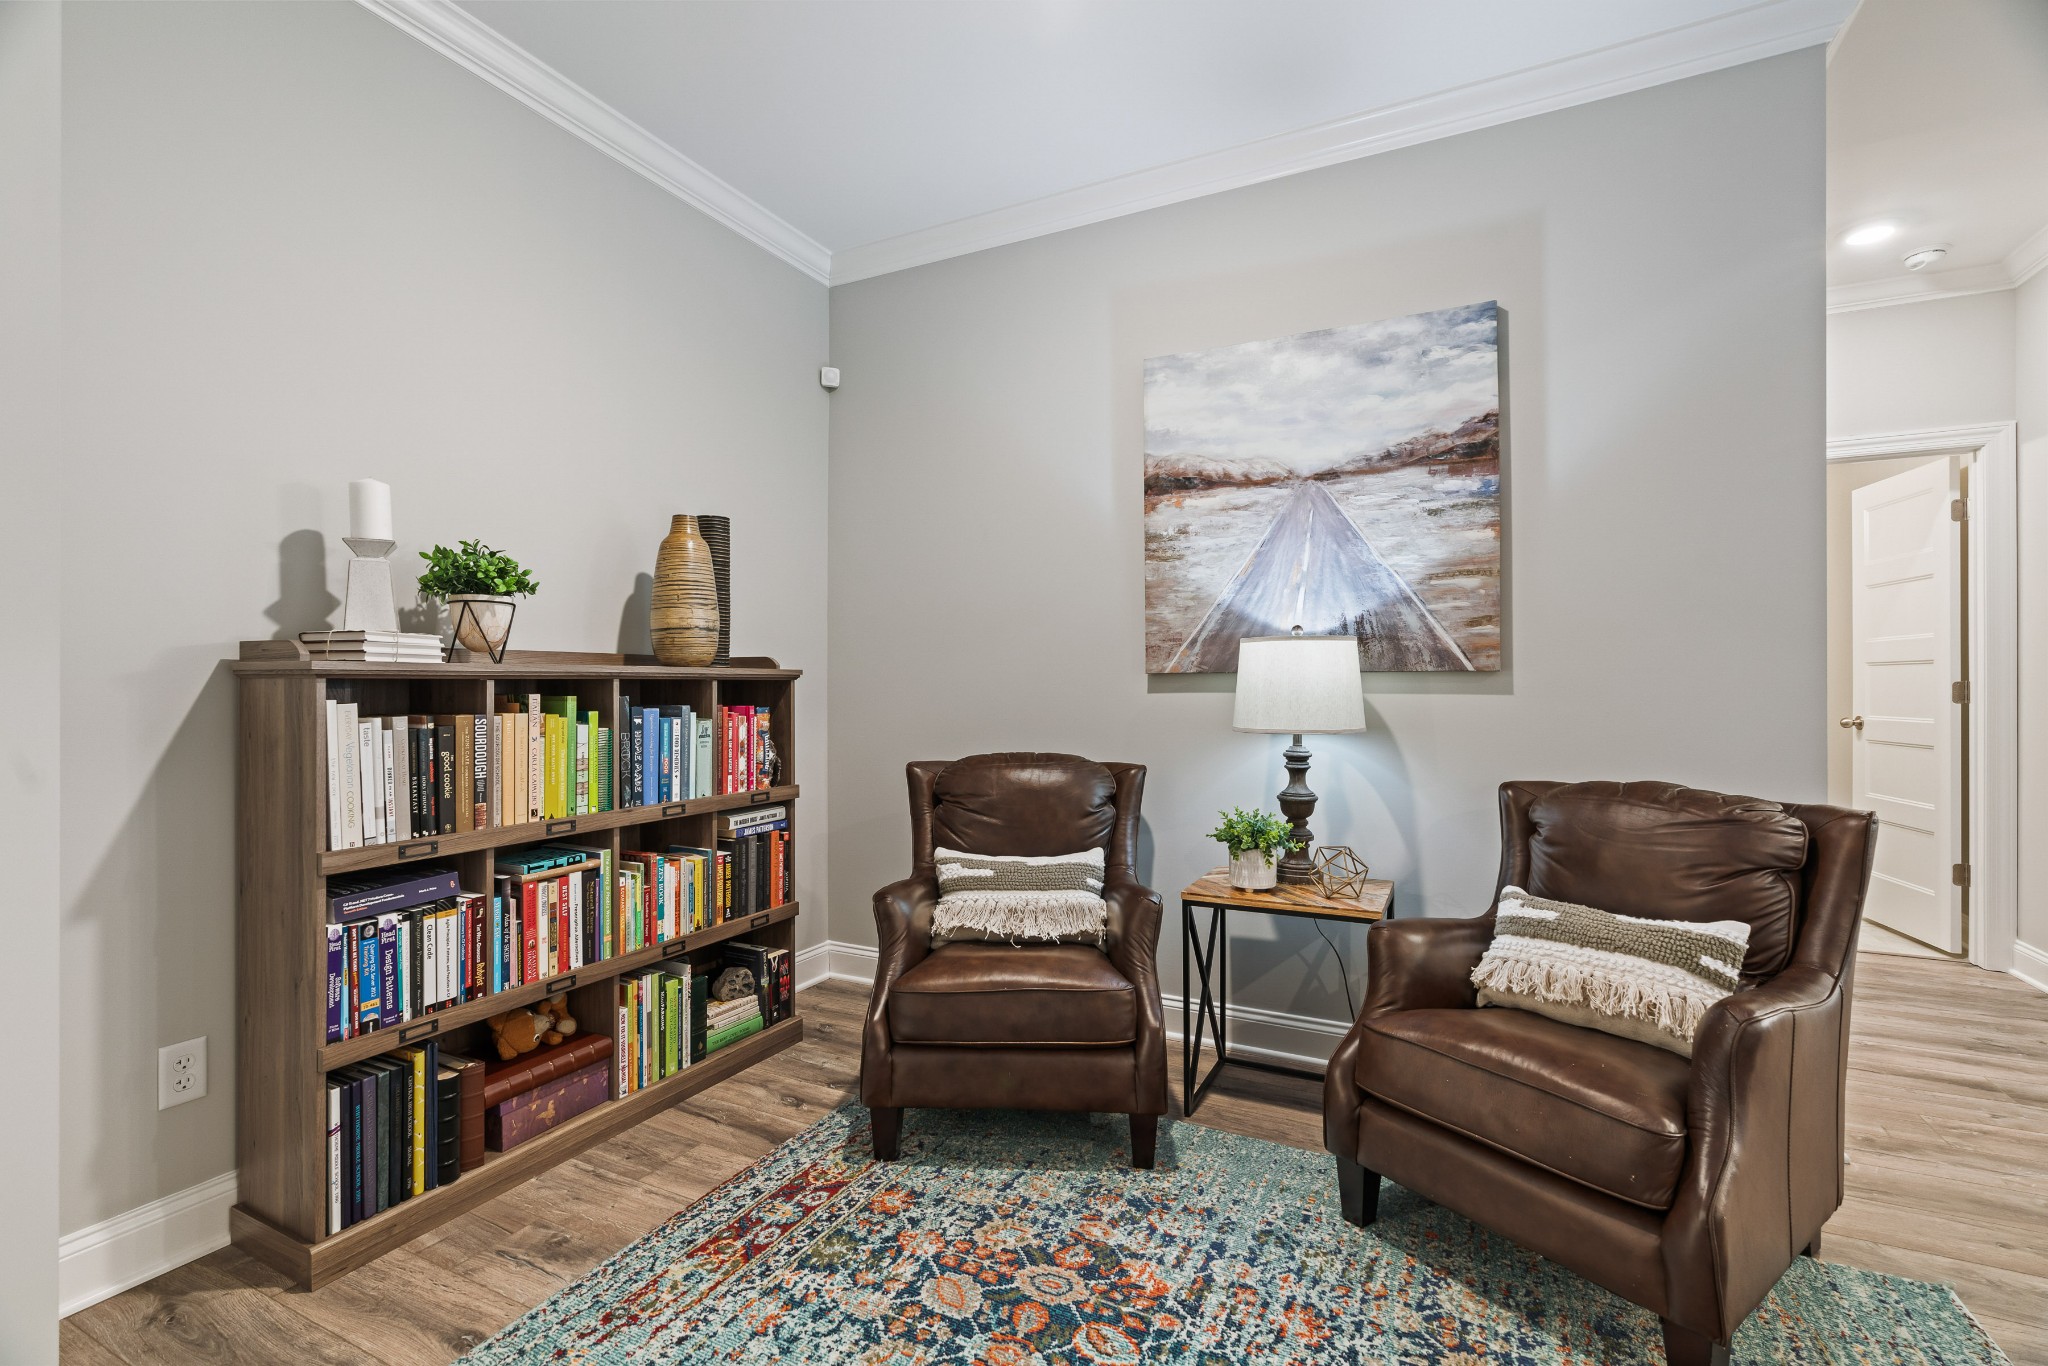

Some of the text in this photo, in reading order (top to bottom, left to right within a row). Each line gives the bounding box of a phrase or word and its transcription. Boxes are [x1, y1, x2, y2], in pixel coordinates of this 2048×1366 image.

[531, 698, 539, 728] ITALIAN
[363, 727, 371, 747] taste
[474, 718, 487, 779] SOURDOUGH
[343, 742, 355, 788] Vegetarian
[441, 751, 453, 799] good cookie
[634, 730, 643, 793] HOME MADE
[346, 791, 355, 829] COOKING
[743, 823, 774, 836] JAMES PATTERSON
[381, 930, 396, 938] Head
[381, 936, 396, 945] First
[328, 973, 336, 1009] Development
[334, 976, 342, 1002] Software
[383, 949, 394, 1010] Design Patterns
[475, 962, 486, 987] Rubyist
